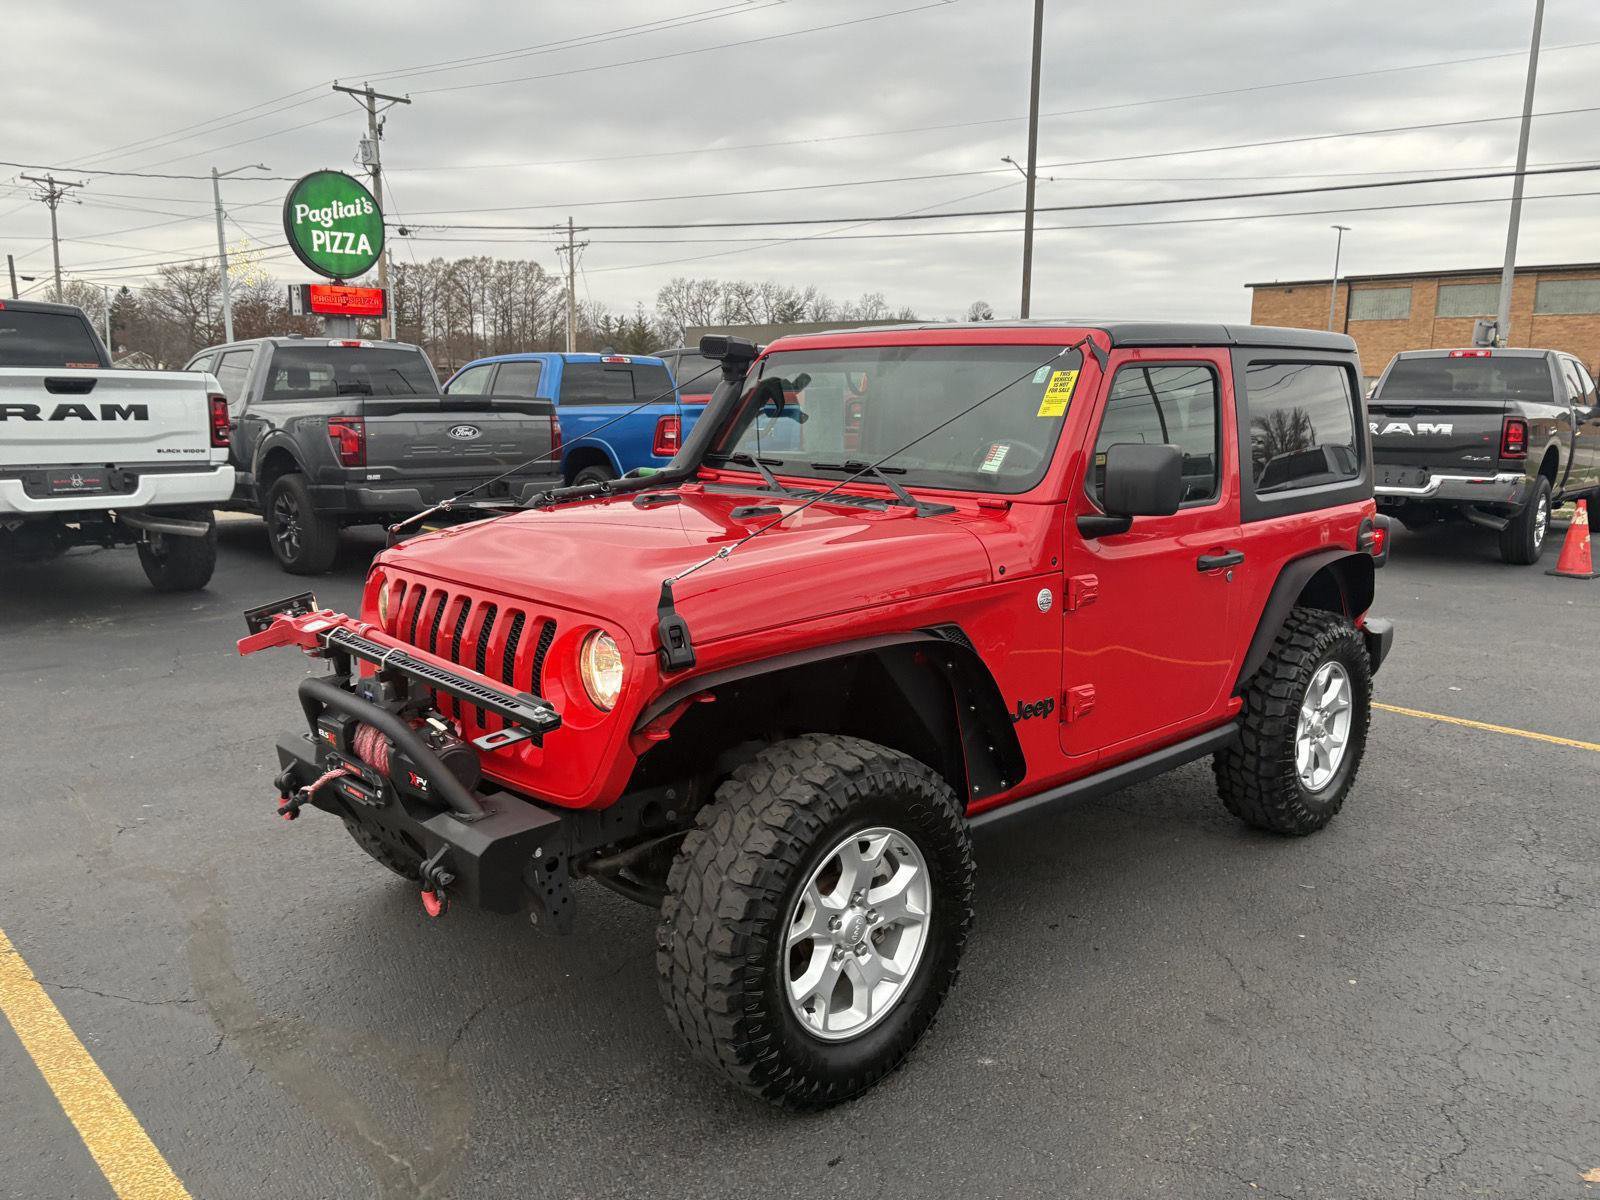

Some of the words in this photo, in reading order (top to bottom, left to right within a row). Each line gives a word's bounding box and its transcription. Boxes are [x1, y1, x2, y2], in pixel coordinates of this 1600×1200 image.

[295, 197, 374, 228] Pagliai's
[311, 230, 373, 256] PIZZA
[0, 403, 149, 421] RAM
[1368, 422, 1454, 436] RAM
[1010, 697, 1054, 723] Jeep
